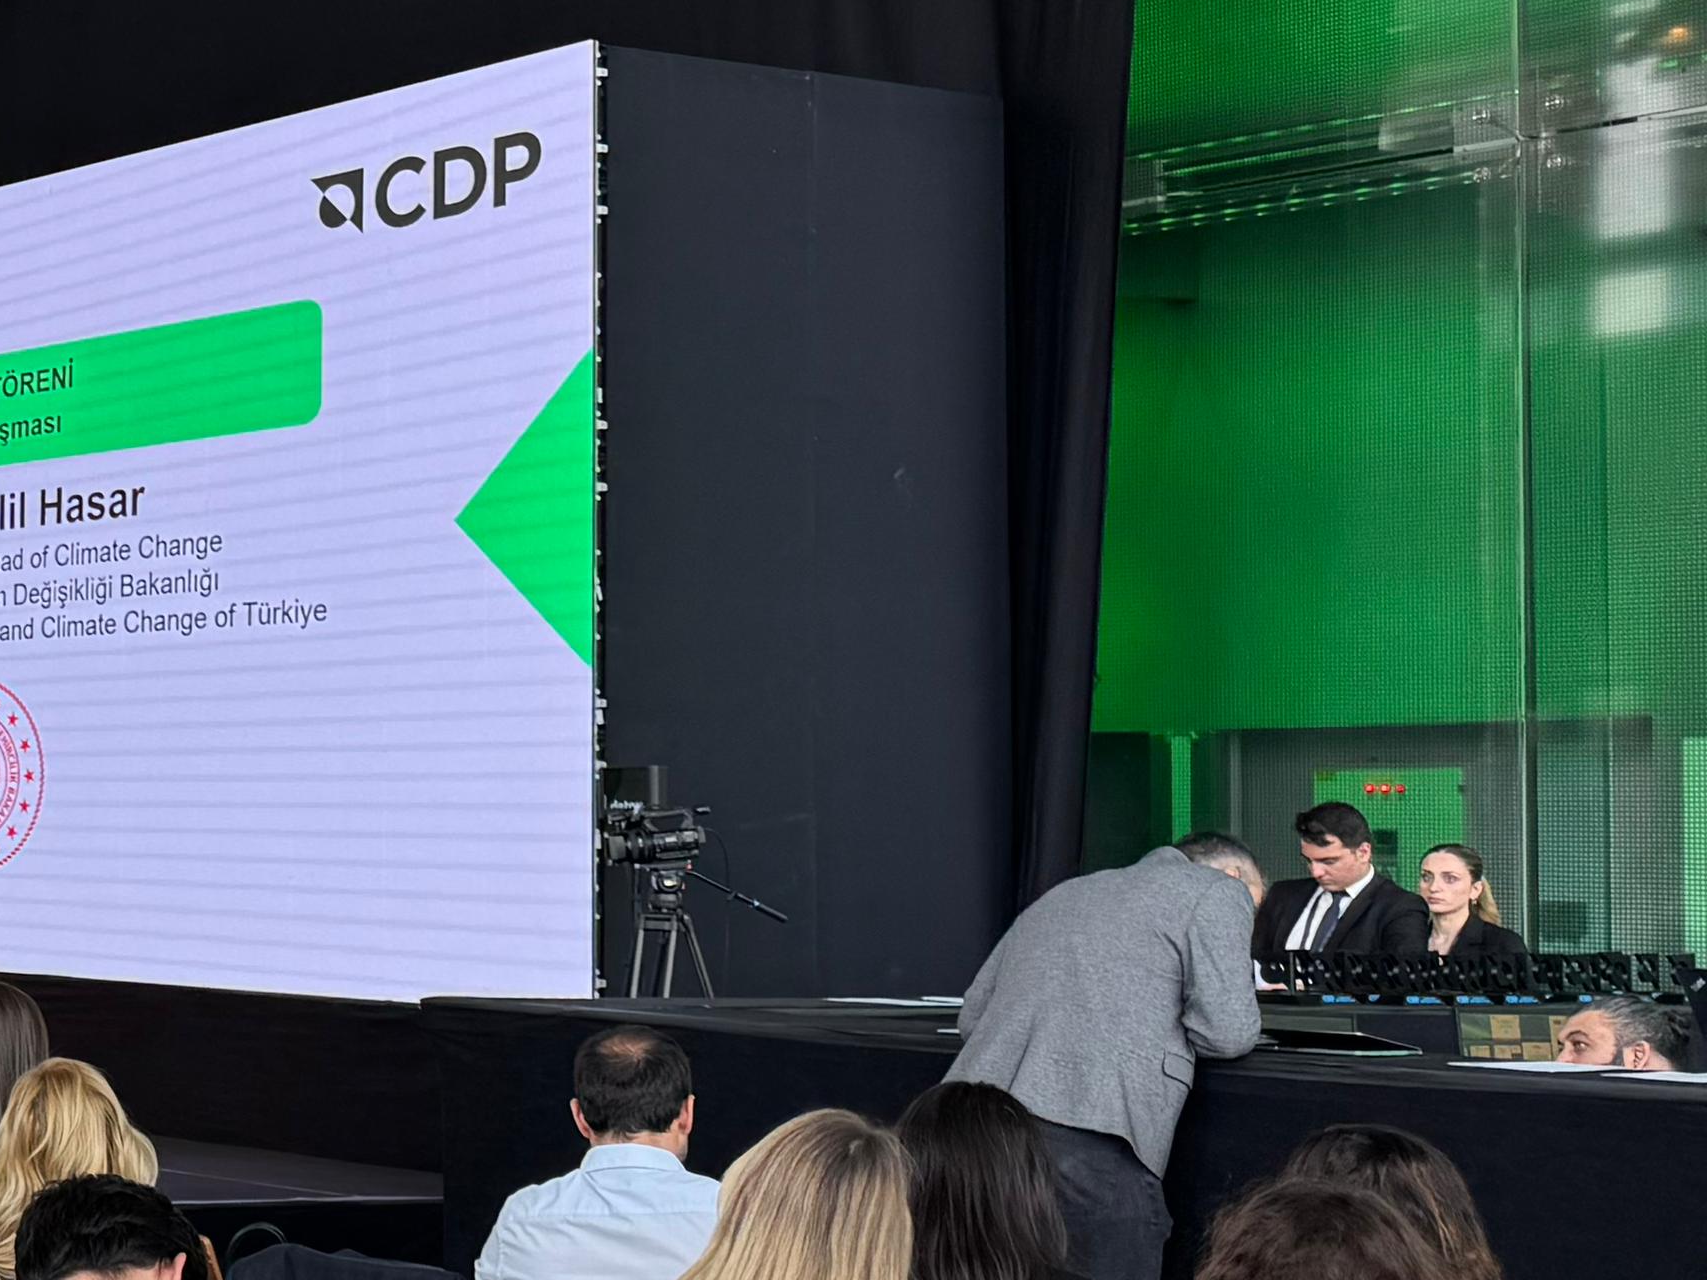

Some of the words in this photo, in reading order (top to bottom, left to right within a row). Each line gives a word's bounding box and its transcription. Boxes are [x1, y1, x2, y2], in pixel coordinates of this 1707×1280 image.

[375, 131, 542, 228] CDP
[40, 486, 145, 526] Hasar
[30, 545, 49, 570] of
[54, 539, 131, 567] Climate
[138, 533, 223, 560] Change
[14, 575, 113, 609] Değişikliği
[120, 568, 220, 598] Bakanlığı
[41, 614, 117, 639] Climate
[123, 609, 207, 636] Change
[214, 605, 237, 628] of
[243, 598, 328, 629] Türkiye
